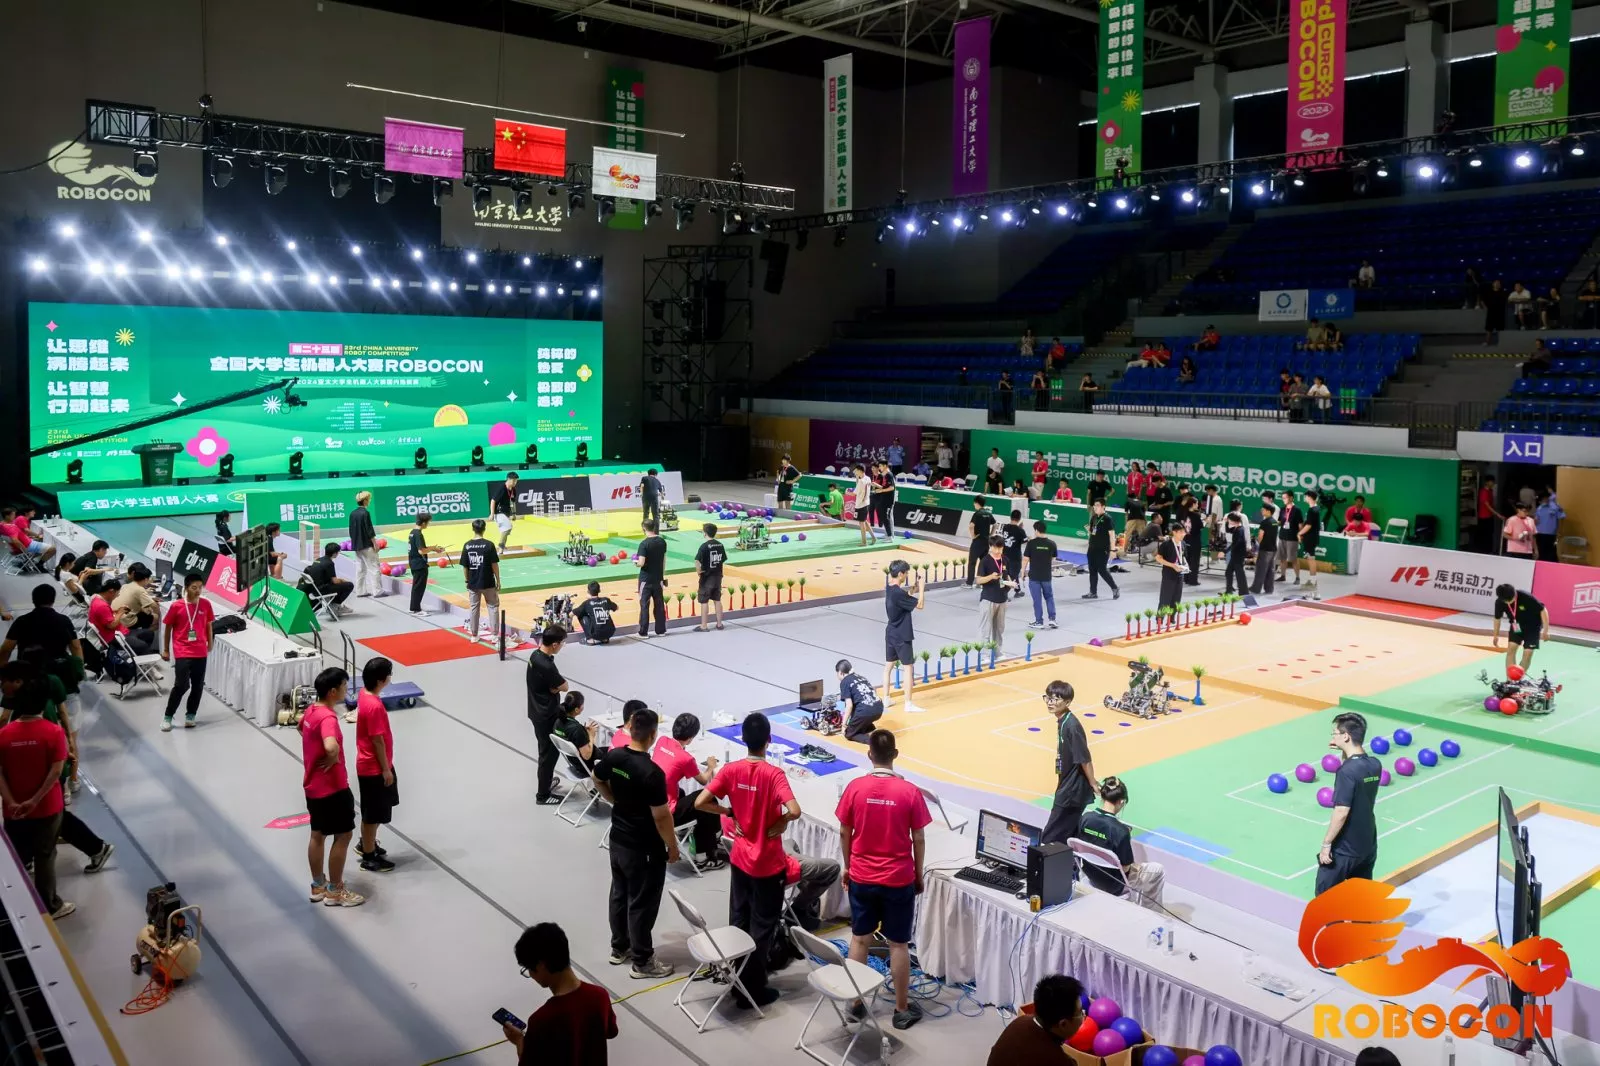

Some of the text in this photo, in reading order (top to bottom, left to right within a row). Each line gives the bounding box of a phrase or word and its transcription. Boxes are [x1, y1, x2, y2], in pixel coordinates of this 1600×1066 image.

[1321, 27, 1331, 77] CURC
[1509, 83, 1555, 101] 23rd
[1303, 106, 1329, 116] 2024
[57, 186, 151, 202] ROBOCON
[210, 357, 484, 373] 全国大学生机器人大赛 ROBOCON
[1505, 440, 1541, 457] 入口
[1046, 468, 1073, 480] 23rd
[1247, 468, 1376, 494] ROBOCON
[81, 493, 219, 510] 全国大学生机器人大赛
[296, 502, 345, 513] 拓竹科技
[396, 494, 460, 506] 23rd CURC
[297, 513, 327, 521] Bambu
[396, 503, 471, 516] ROBOCON
[1433, 582, 1493, 597] MAMMOTION
